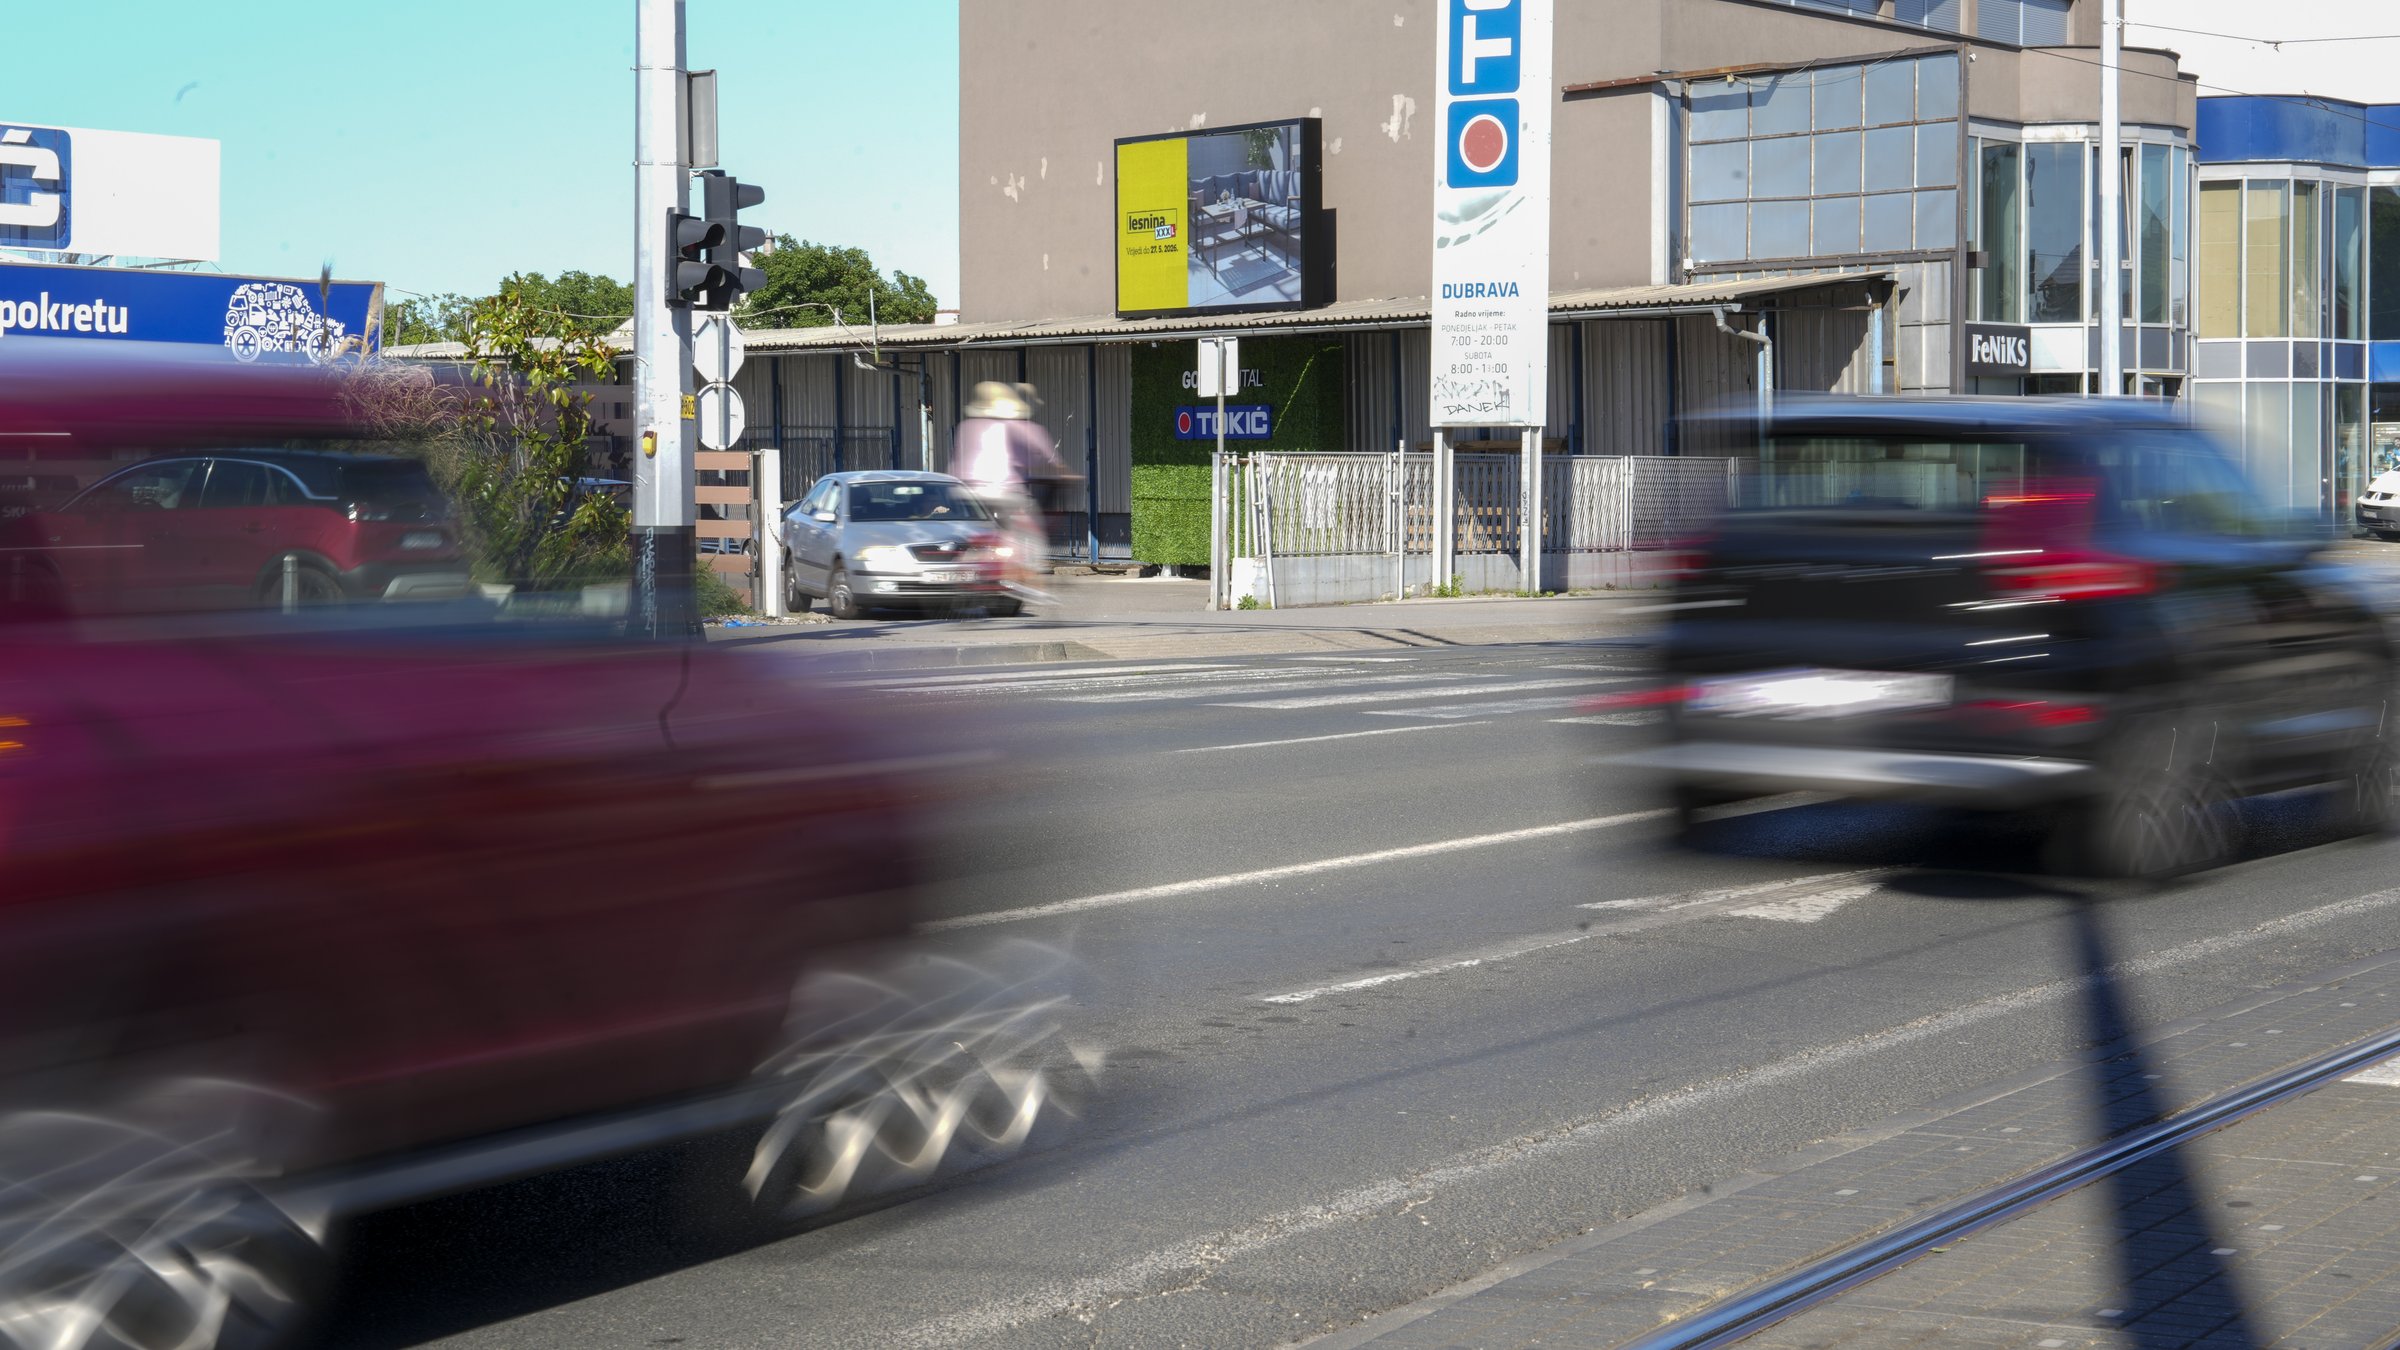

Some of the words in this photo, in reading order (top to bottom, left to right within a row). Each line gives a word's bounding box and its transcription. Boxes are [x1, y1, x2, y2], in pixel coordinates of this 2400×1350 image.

[1128, 214, 1165, 230] lesnina
[1156, 226, 1175, 237] XXXL
[1442, 282, 1520, 299] DUBRAVA
[0, 291, 128, 338] pokretu
[1454, 310, 1476, 318] Radno
[1478, 310, 1506, 319] vrijeme:
[1441, 324, 1488, 332] PONEDJELJAK
[1494, 323, 1517, 331] PETAK
[1451, 336, 1471, 346] 7:00
[1480, 335, 1508, 346] 20:00
[1464, 352, 1492, 360] SUBOTA
[1450, 364, 1472, 374] 8:00
[1443, 400, 1510, 416] DANEK
[1196, 406, 1268, 435] TOKIĆ
